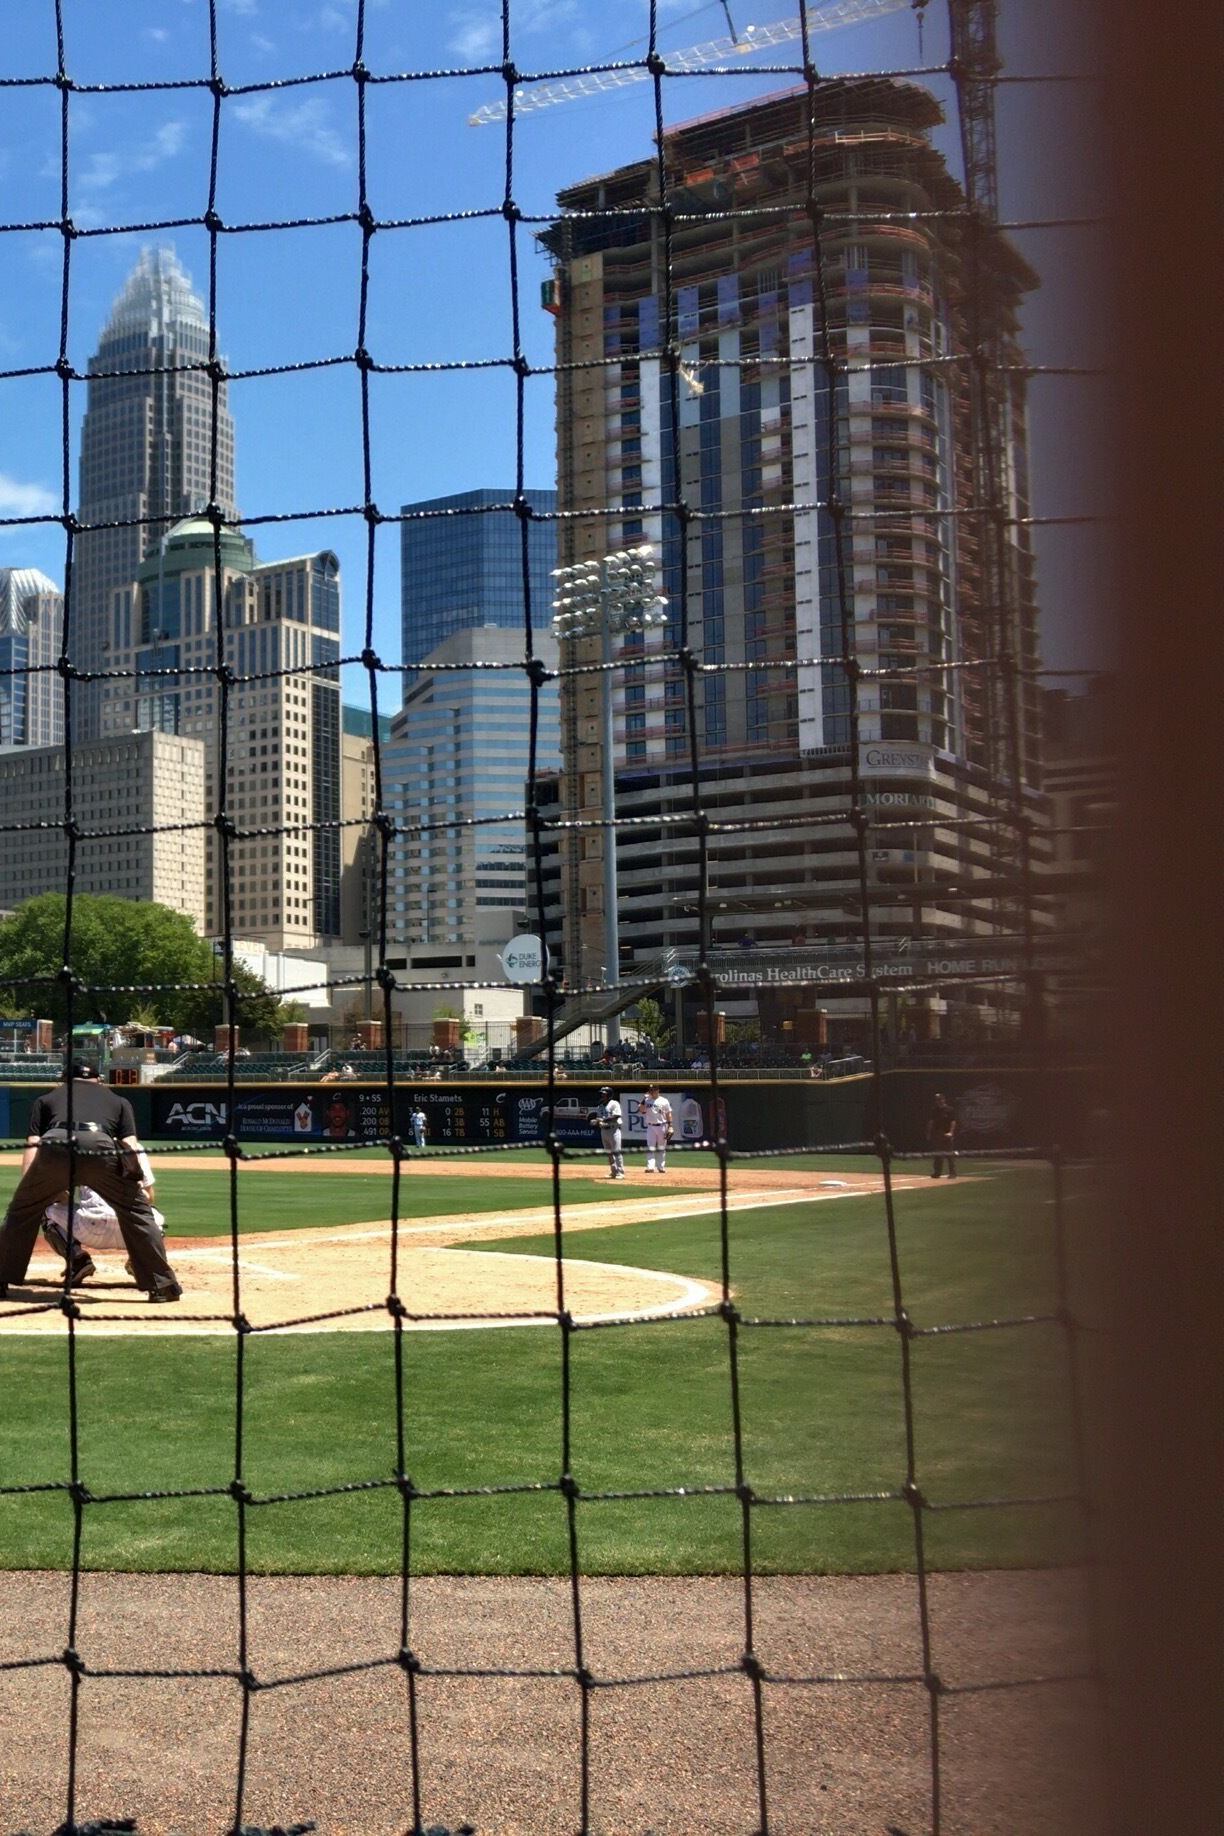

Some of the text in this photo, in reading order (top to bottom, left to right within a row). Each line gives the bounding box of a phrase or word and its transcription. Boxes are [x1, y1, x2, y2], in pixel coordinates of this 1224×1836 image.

[866, 750, 922, 766] GREYST
[767, 965, 853, 981] HealthCare
[856, 963, 913, 978] Sstem
[927, 960, 975, 974] HOME
[414, 1094, 463, 1103] Eric Stamets
[166, 1103, 226, 1124] ACN
[360, 1107, 376, 1115] .200
